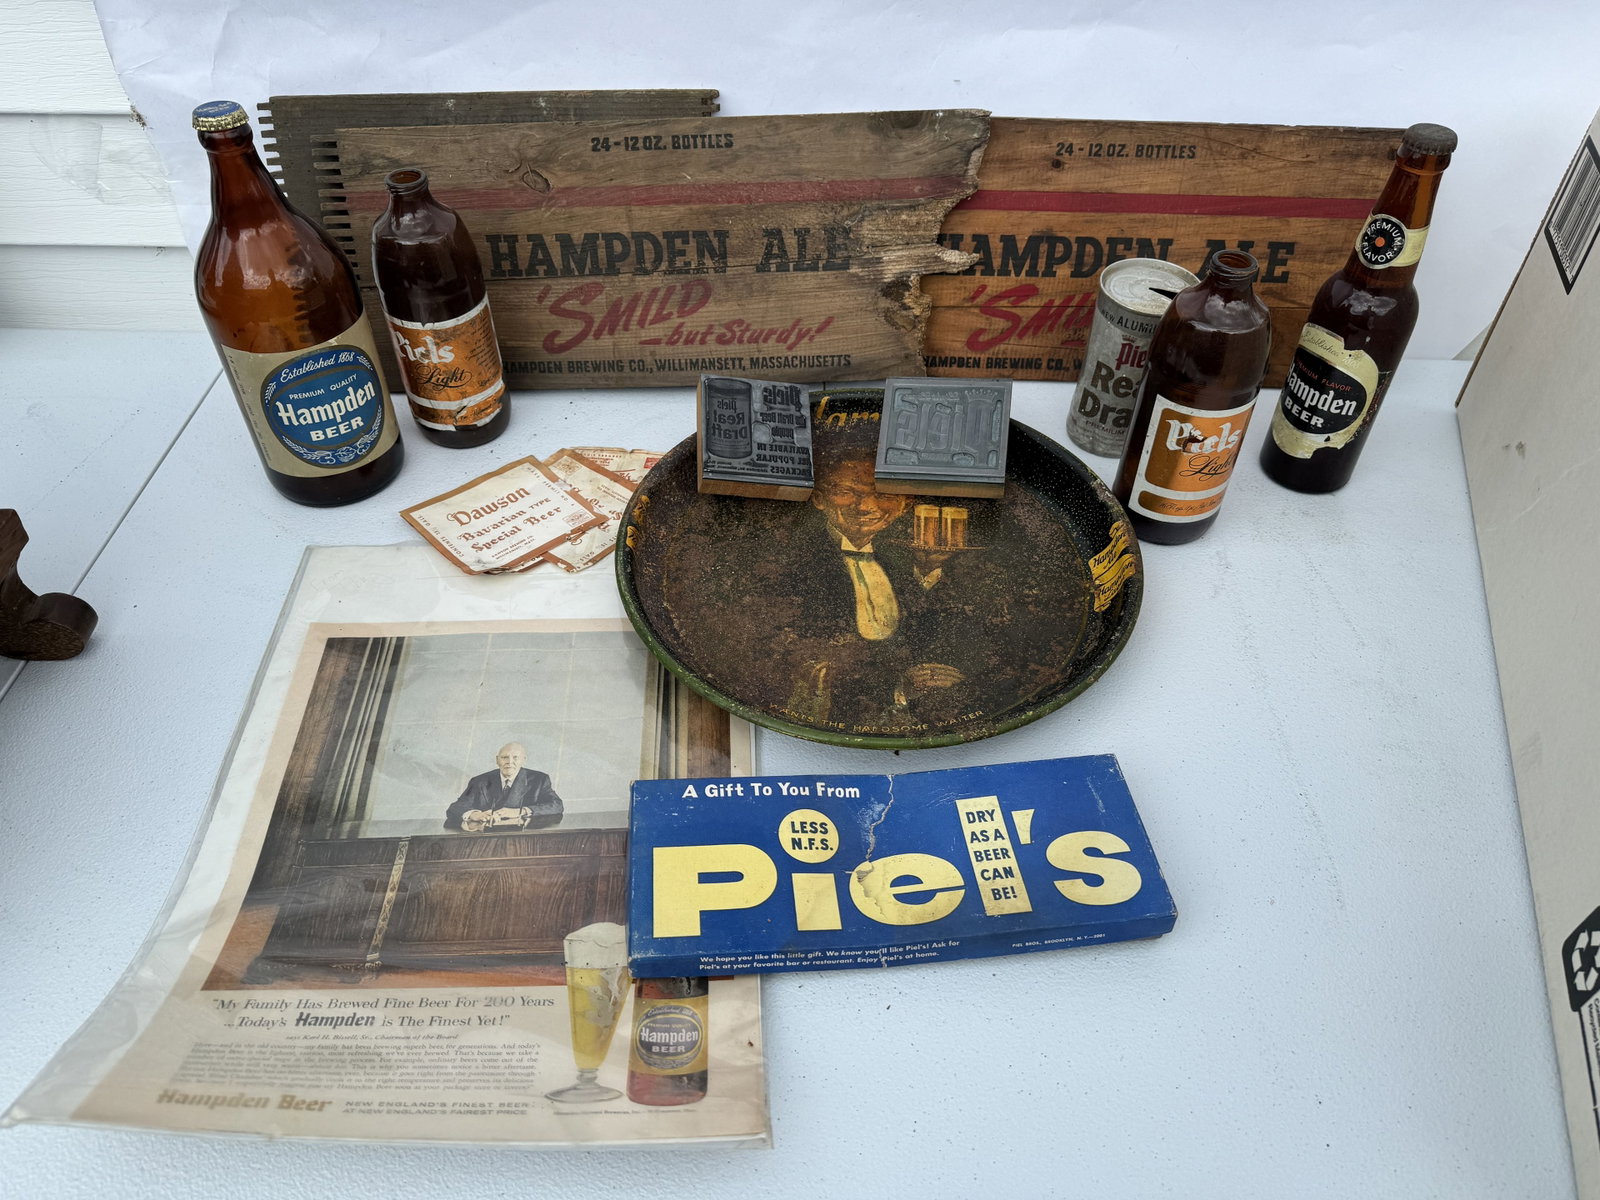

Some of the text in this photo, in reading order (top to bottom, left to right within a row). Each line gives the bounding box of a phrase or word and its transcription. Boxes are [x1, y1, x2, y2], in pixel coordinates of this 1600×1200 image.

[642, 135, 667, 150] OZ.
[671, 133, 734, 149] BOTTLES
[1106, 143, 1129, 158] OZ.
[1135, 144, 1197, 159] BOTTLES
[1366, 222, 1402, 246] PREMIUM
[485, 226, 850, 277] HAMPDEN ALE
[1362, 242, 1394, 262] FLAVOR
[715, 316, 836, 351] Sturdy!
[280, 355, 336, 383] Established
[503, 360, 563, 374] HAMPDEN
[567, 359, 625, 373] BREWING
[654, 357, 746, 372] WILLIMANSETT,
[750, 354, 851, 370] MASSACHUSETTS
[985, 357, 1042, 370] BREWING
[416, 363, 473, 391] Light
[1321, 378, 1353, 392] FLAVOR
[289, 373, 358, 400] PREMIUM QUALITY
[275, 381, 376, 427] Hampden
[1078, 387, 1133, 428] Dra
[1284, 396, 1325, 428] BEER
[310, 416, 365, 442] BEER
[446, 487, 531, 526] Dawson
[457, 510, 526, 541] Bavarian
[529, 497, 551, 510] TYPE
[471, 525, 522, 553] Special
[523, 507, 561, 526] Beer
[682, 782, 860, 798] A Gift To You From
[965, 809, 996, 824] DRY
[790, 821, 829, 834] LESS
[970, 828, 1005, 843] AS A
[792, 838, 834, 851] N.F.S.
[973, 847, 1011, 862] BEER
[652, 795, 1142, 938] Piel's
[980, 866, 1015, 881] CAN
[991, 886, 1018, 901] BE!
[808, 951, 823, 959] gift.
[813, 957, 854, 965] restaurant.
[243, 998, 291, 1012] Family
[296, 998, 322, 1009] Has
[327, 998, 379, 1009] Brewed
[384, 997, 414, 1008] Fine
[418, 997, 451, 1008] Beer
[455, 996, 478, 1007] For
[520, 995, 555, 1007] Years
[295, 1011, 376, 1029] Hampden
[382, 1016, 393, 1026] is
[398, 1015, 424, 1026] The
[428, 1015, 472, 1026] Finest
[640, 1027, 698, 1045] Hampden
[652, 1045, 686, 1053] BEER
[157, 1089, 332, 1112] Hampden Beer
